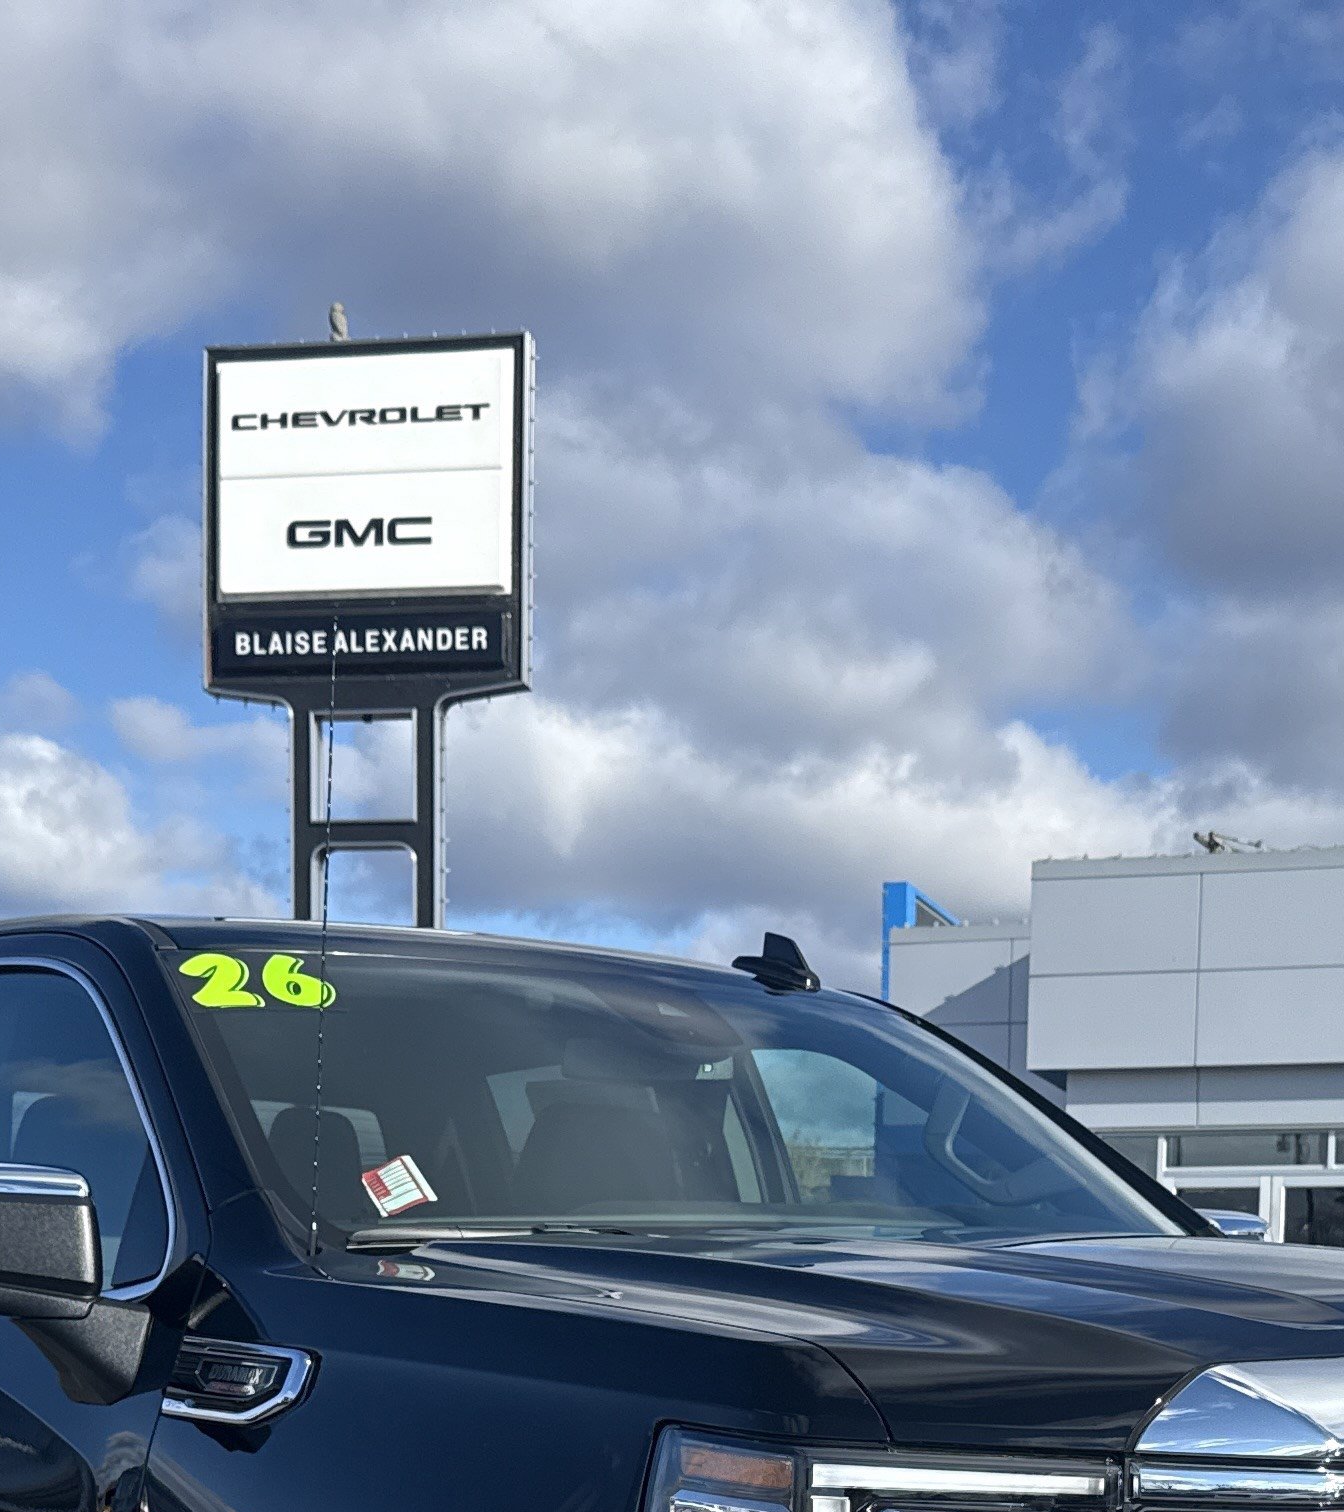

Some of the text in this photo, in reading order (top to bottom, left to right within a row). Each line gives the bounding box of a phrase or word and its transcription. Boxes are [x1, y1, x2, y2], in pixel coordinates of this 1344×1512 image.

[231, 402, 491, 432] CHEVROLET
[286, 516, 433, 550] GMC
[235, 626, 488, 656] BLAISE ALEXANDER
[178, 953, 336, 1008] 26
